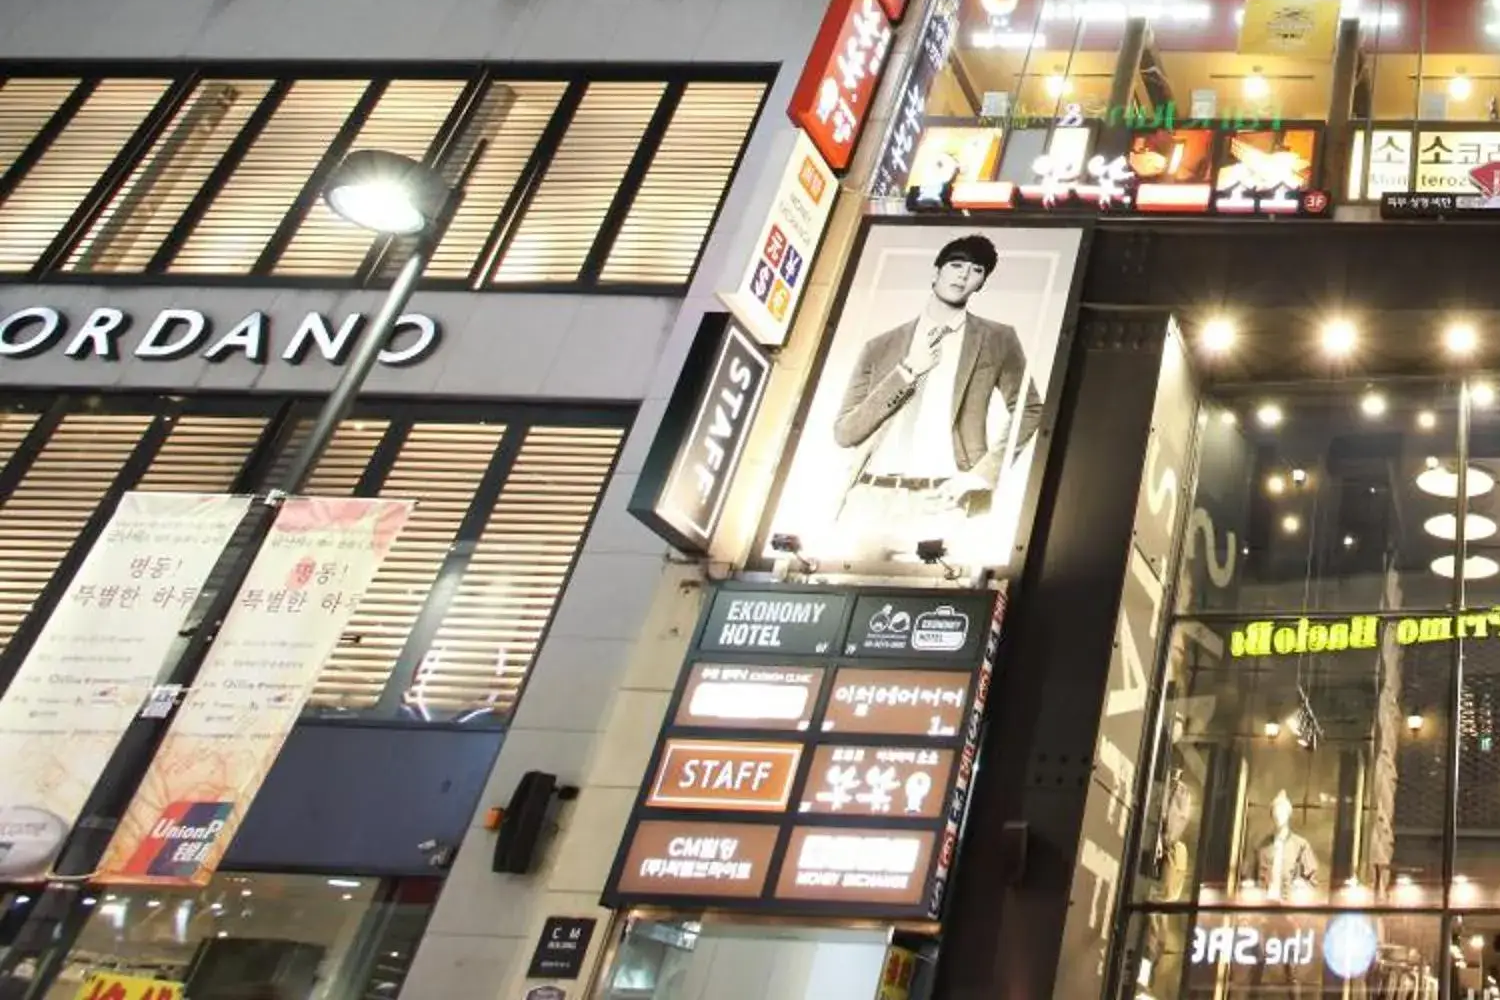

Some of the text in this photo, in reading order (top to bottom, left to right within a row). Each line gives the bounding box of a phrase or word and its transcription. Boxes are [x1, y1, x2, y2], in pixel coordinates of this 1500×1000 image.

[692, 355, 752, 506] STAFF
[726, 599, 826, 623] EKONOMY
[718, 623, 782, 647] HOTEL
[678, 759, 774, 792] STAFF
[151, 818, 224, 841] UnionP
